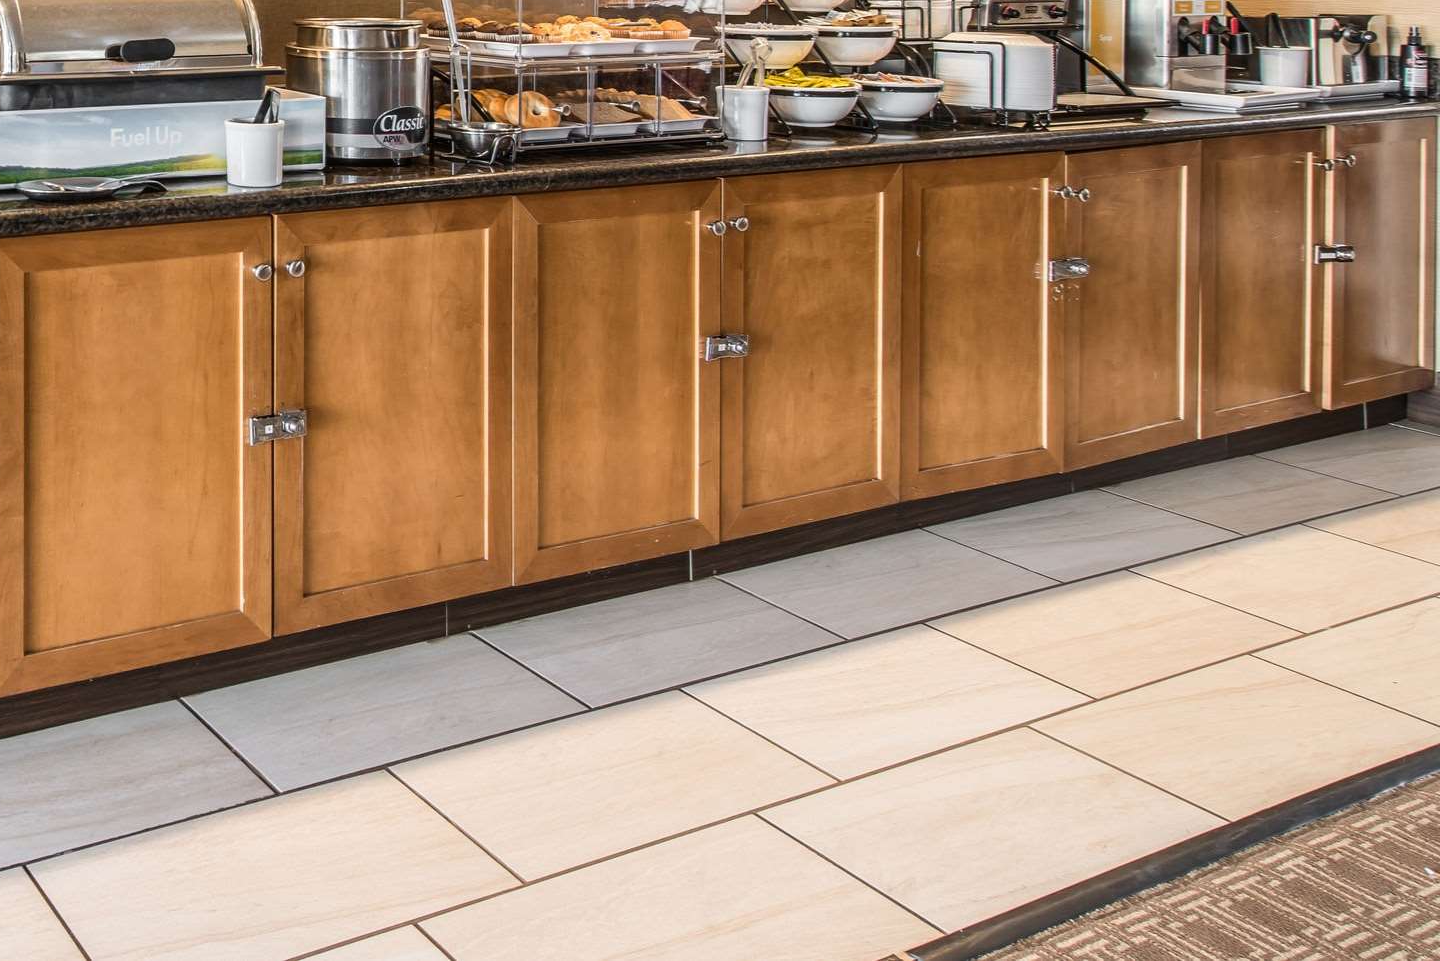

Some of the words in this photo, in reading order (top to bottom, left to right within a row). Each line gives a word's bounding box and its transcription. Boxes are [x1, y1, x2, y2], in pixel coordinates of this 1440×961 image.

[380, 112, 424, 133] Classic
[111, 126, 150, 147] Fuel
[155, 125, 183, 155] Up
[383, 135, 401, 143] APW
